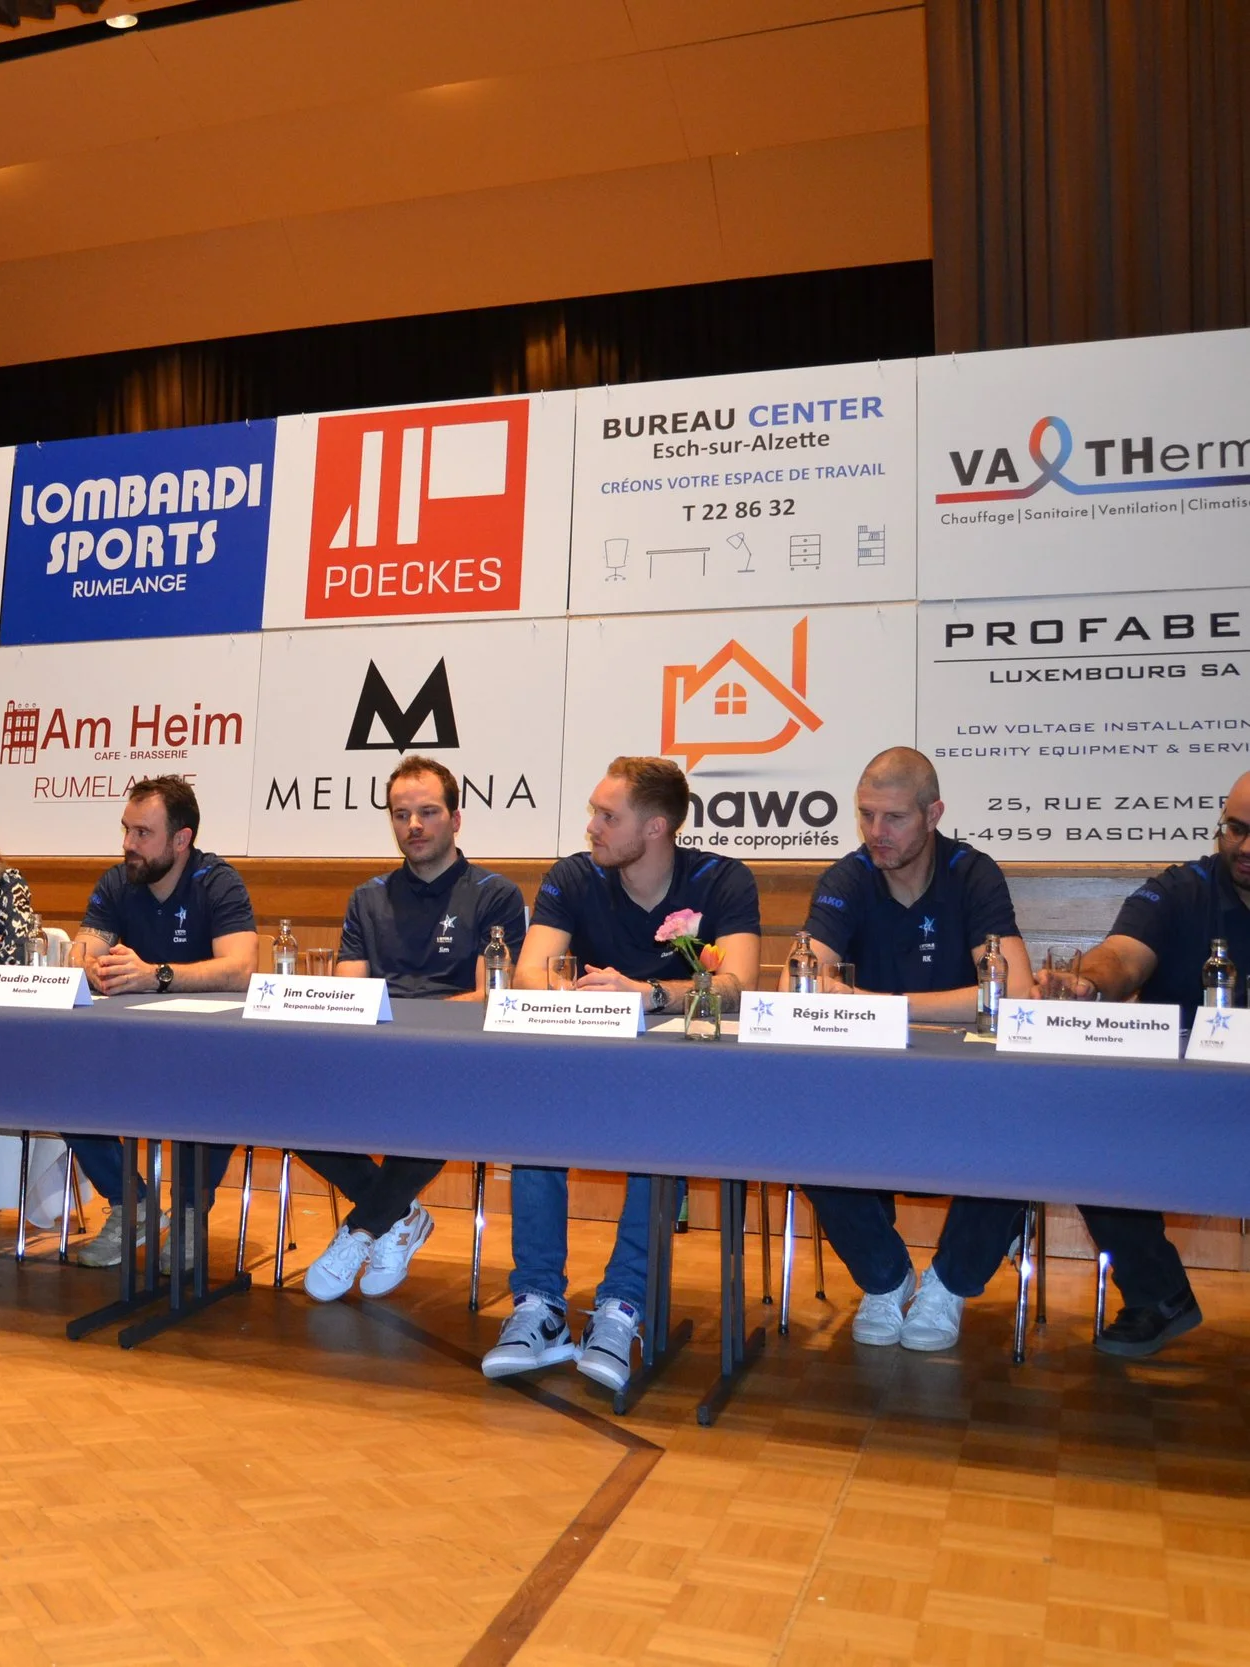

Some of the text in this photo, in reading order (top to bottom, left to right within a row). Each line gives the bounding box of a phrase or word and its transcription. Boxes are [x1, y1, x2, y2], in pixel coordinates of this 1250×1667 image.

[602, 396, 885, 440] BUREAU CENTER
[653, 431, 830, 460] Esch-sur-Alzette
[601, 463, 886, 495] CRÉONS VOTRE ESPACE DE TRAVAIL
[20, 463, 263, 527] LOMBARDI
[682, 498, 796, 522] T 22 86 32
[1024, 507, 1089, 521] Sanitaire
[1098, 502, 1178, 517] Ventilation
[46, 519, 218, 575] SPORTS
[72, 574, 186, 598] RUMELANGE
[324, 557, 503, 600] POECKES
[989, 662, 1241, 684] LUXEMBOURG SA
[40, 703, 243, 750] Am Heim
[957, 724, 998, 735] LOW
[1004, 722, 1096, 734] VOLTAGE
[94, 750, 188, 761] CAFE BRASSERIE
[935, 742, 1250, 758] SECURITY EQUIPMENT & SERVI
[265, 773, 537, 811] MELUNA
[987, 797, 1031, 813] 25,
[1044, 796, 1102, 811] RUE
[708, 832, 729, 846] de
[734, 830, 839, 850] copropriétés
[954, 827, 1053, 842] L-4959
[32, 975, 70, 984] Piccotti
[283, 988, 355, 1000] Jim Crovisier
[283, 1003, 364, 1013] Responsable Sponsoring
[521, 1002, 632, 1014] Damien Lambert
[793, 1007, 876, 1021] Régis Kirsch
[528, 1017, 620, 1026] Responsable Sponsoring
[813, 1025, 849, 1033] Membre
[1046, 1015, 1170, 1031] Micky Moutinho
[1085, 1034, 1124, 1043] Membre
